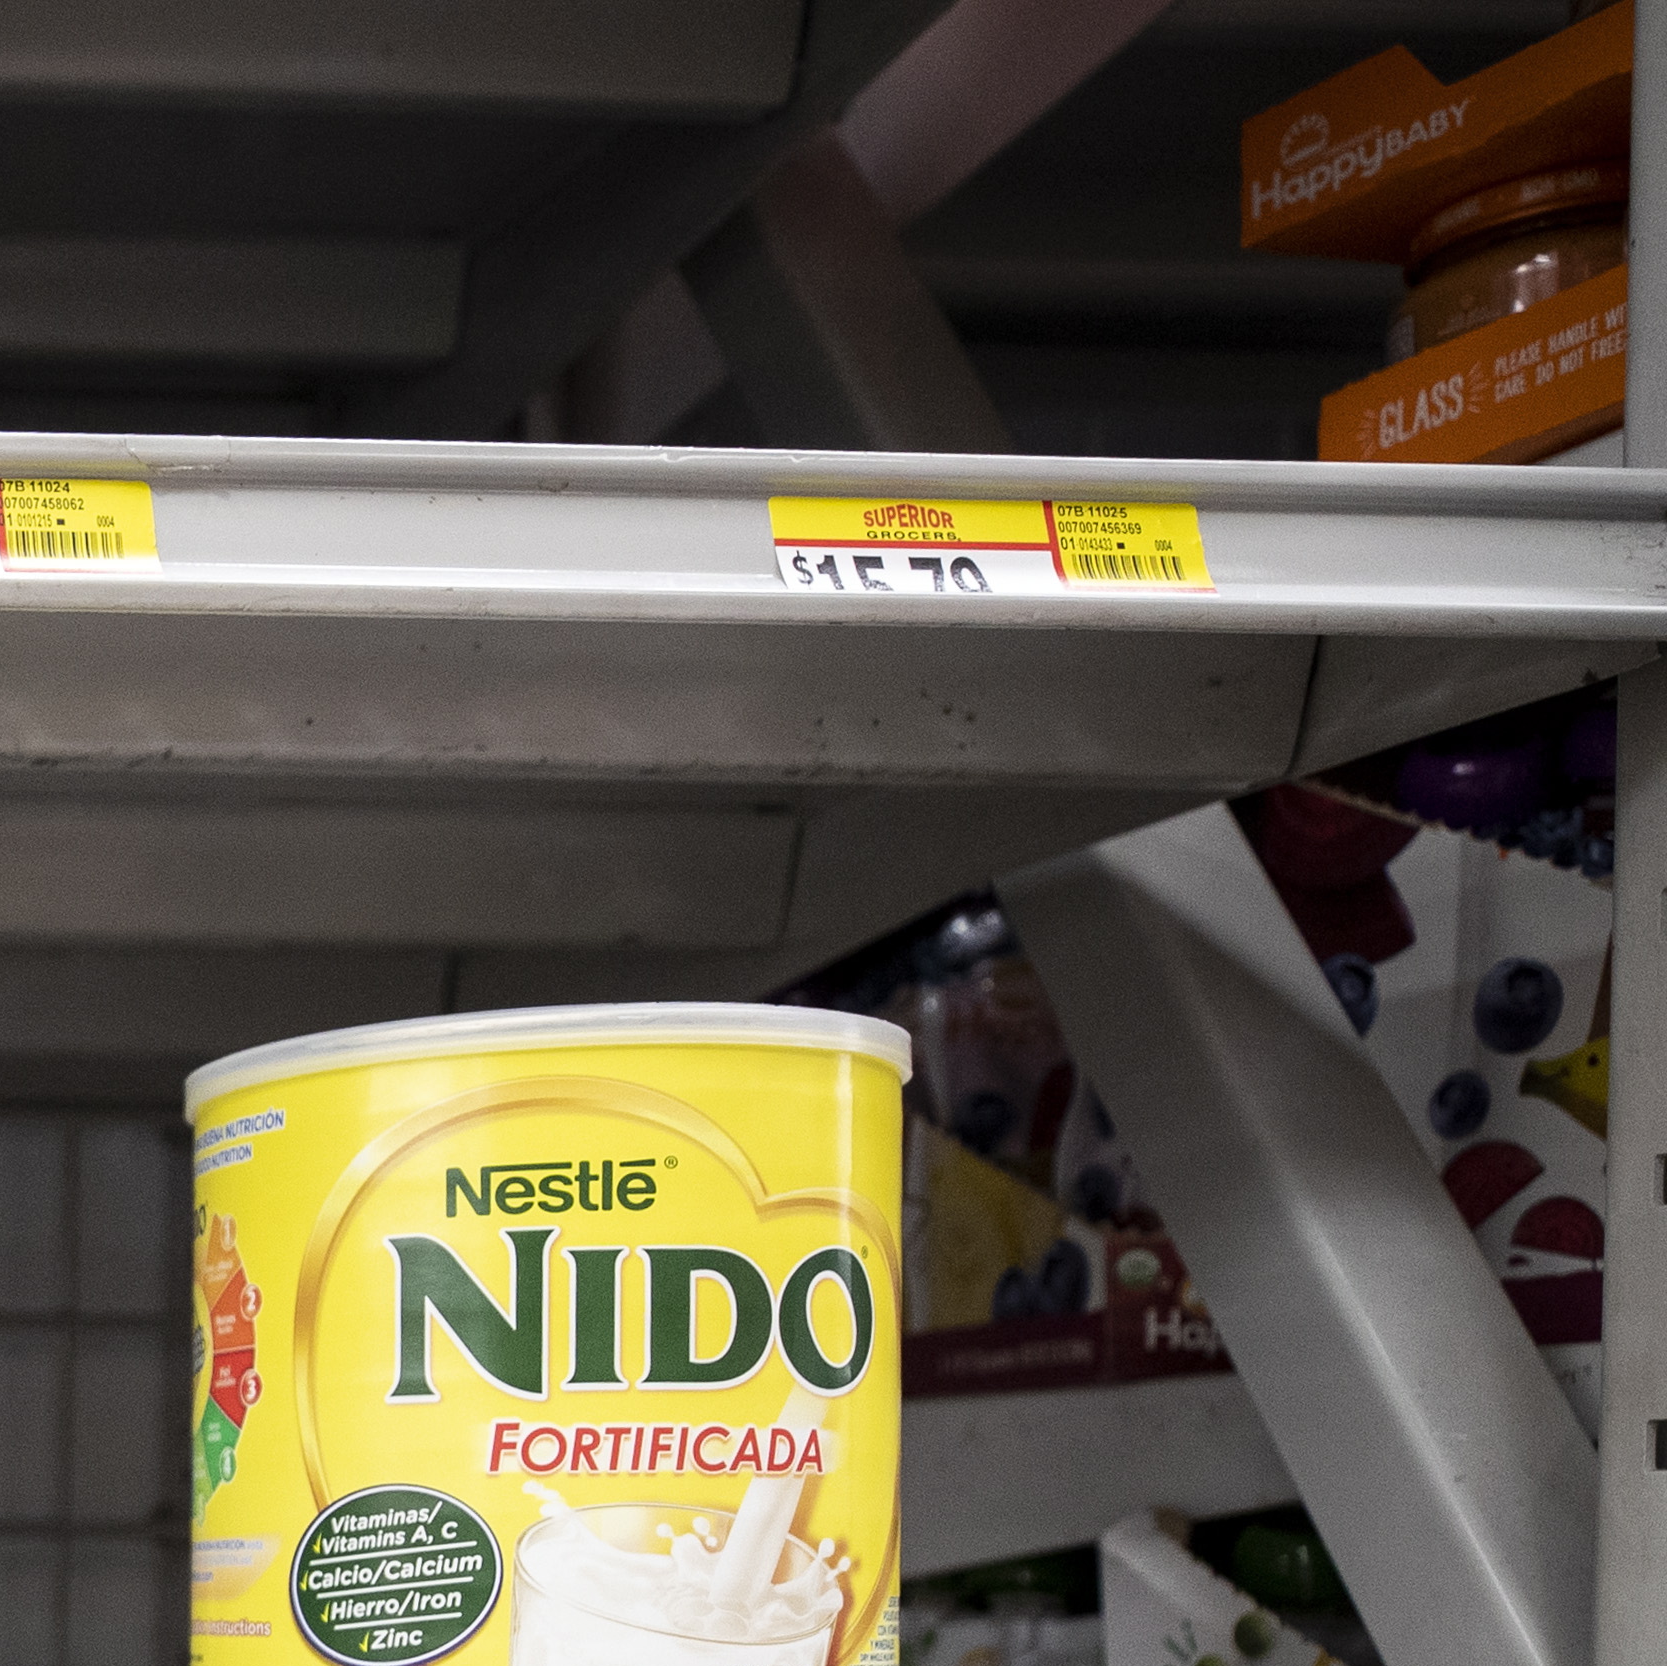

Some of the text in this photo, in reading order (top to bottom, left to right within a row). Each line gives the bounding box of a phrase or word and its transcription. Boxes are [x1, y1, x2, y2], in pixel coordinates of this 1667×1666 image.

[1376, 373, 1465, 449] GLASS
[446, 1159, 657, 1218] Nestlé
[387, 1228, 875, 1402] NIDO
[488, 1423, 826, 1476] FORTIFICADA
[331, 1503, 444, 1534] Vitaminas/
[321, 1521, 459, 1555] Vitamins A, C
[308, 1553, 483, 1590] Calcio/Calcium
[329, 1588, 462, 1622] Hierro/Iron
[372, 1628, 424, 1650] Zinc
